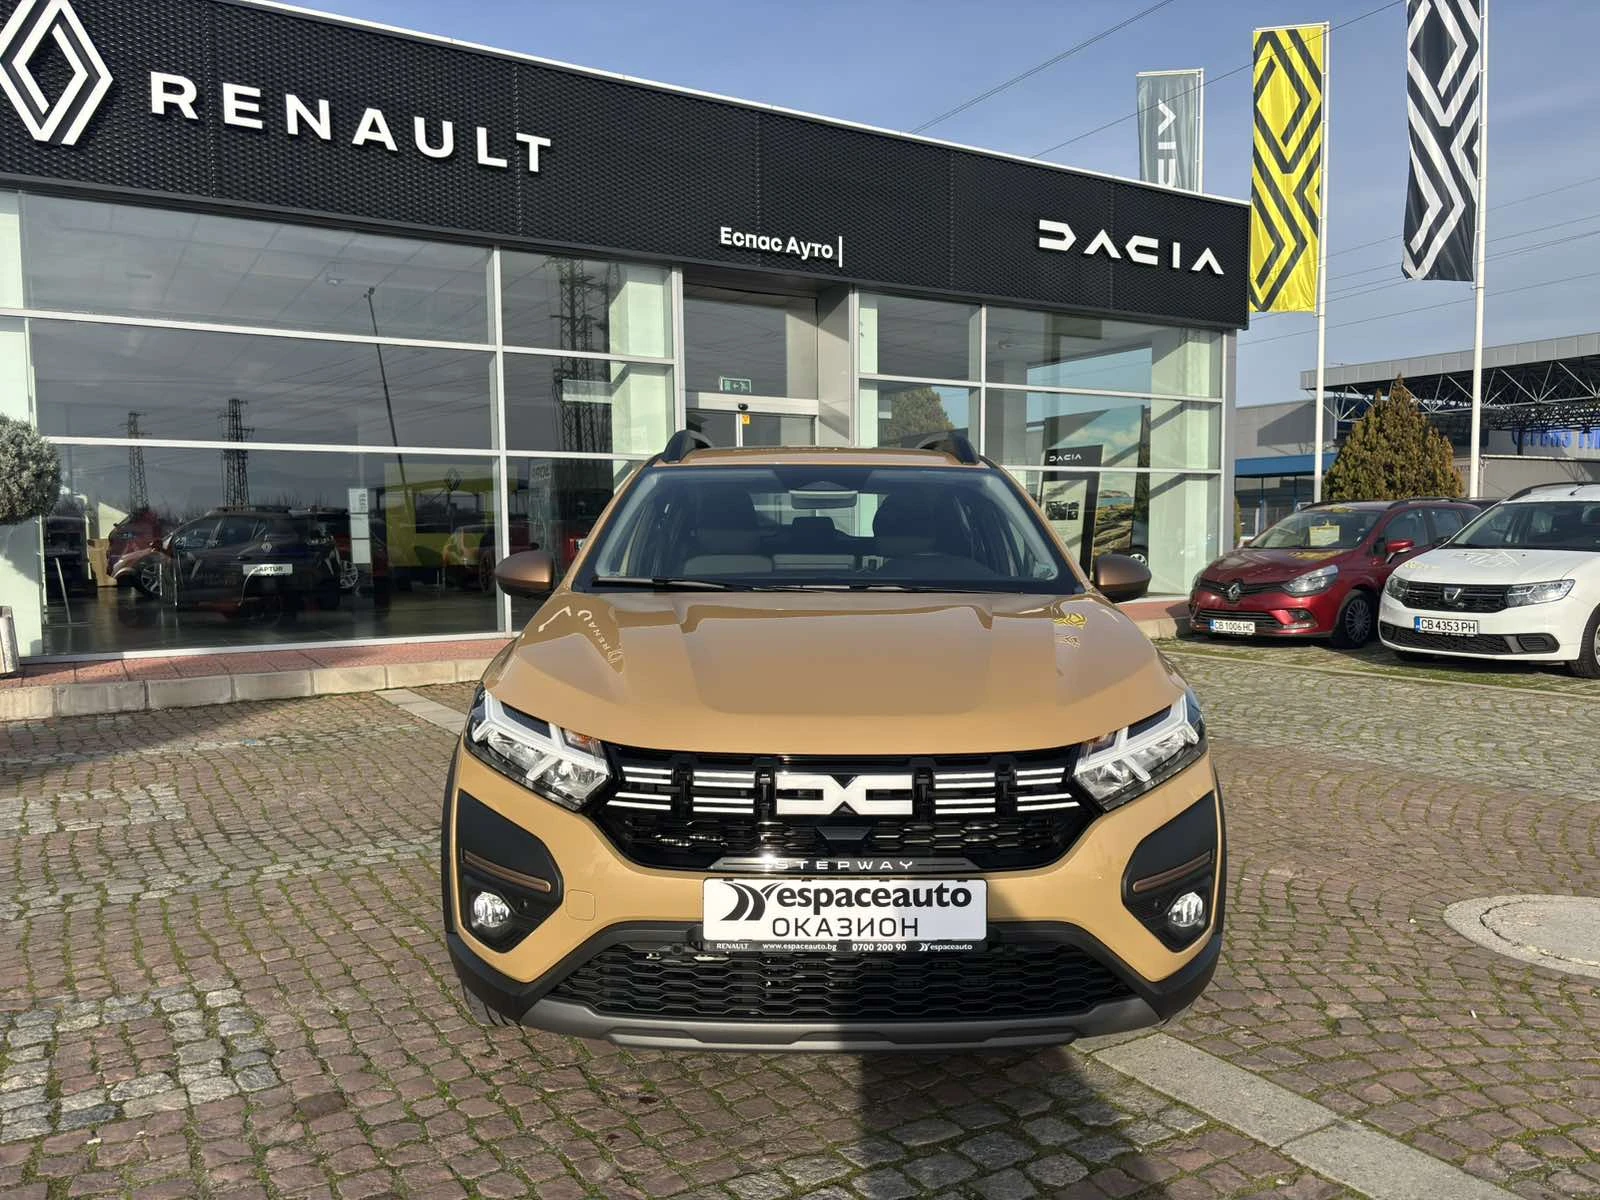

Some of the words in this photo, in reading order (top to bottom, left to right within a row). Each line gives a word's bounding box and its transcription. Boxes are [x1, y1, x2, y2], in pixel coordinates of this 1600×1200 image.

[150, 70, 552, 173] RENAULT
[720, 226, 783, 252] Еспас
[785, 236, 834, 261] Ауто
[1039, 219, 1224, 275] DACIA
[1049, 454, 1082, 462] DACIA
[1421, 619, 1434, 630] CB
[1435, 620, 1459, 631] 4353
[1460, 622, 1476, 633] PH
[774, 860, 913, 870] STEPWAY
[777, 882, 973, 915] espaceauto
[772, 917, 919, 937] ОКАЗИОН
[762, 942, 838, 951] www.espaceauto.bg
[852, 942, 875, 951] 0700
[876, 942, 893, 951] 200
[895, 942, 907, 951] 90
[929, 943, 973, 951] espaceauto
